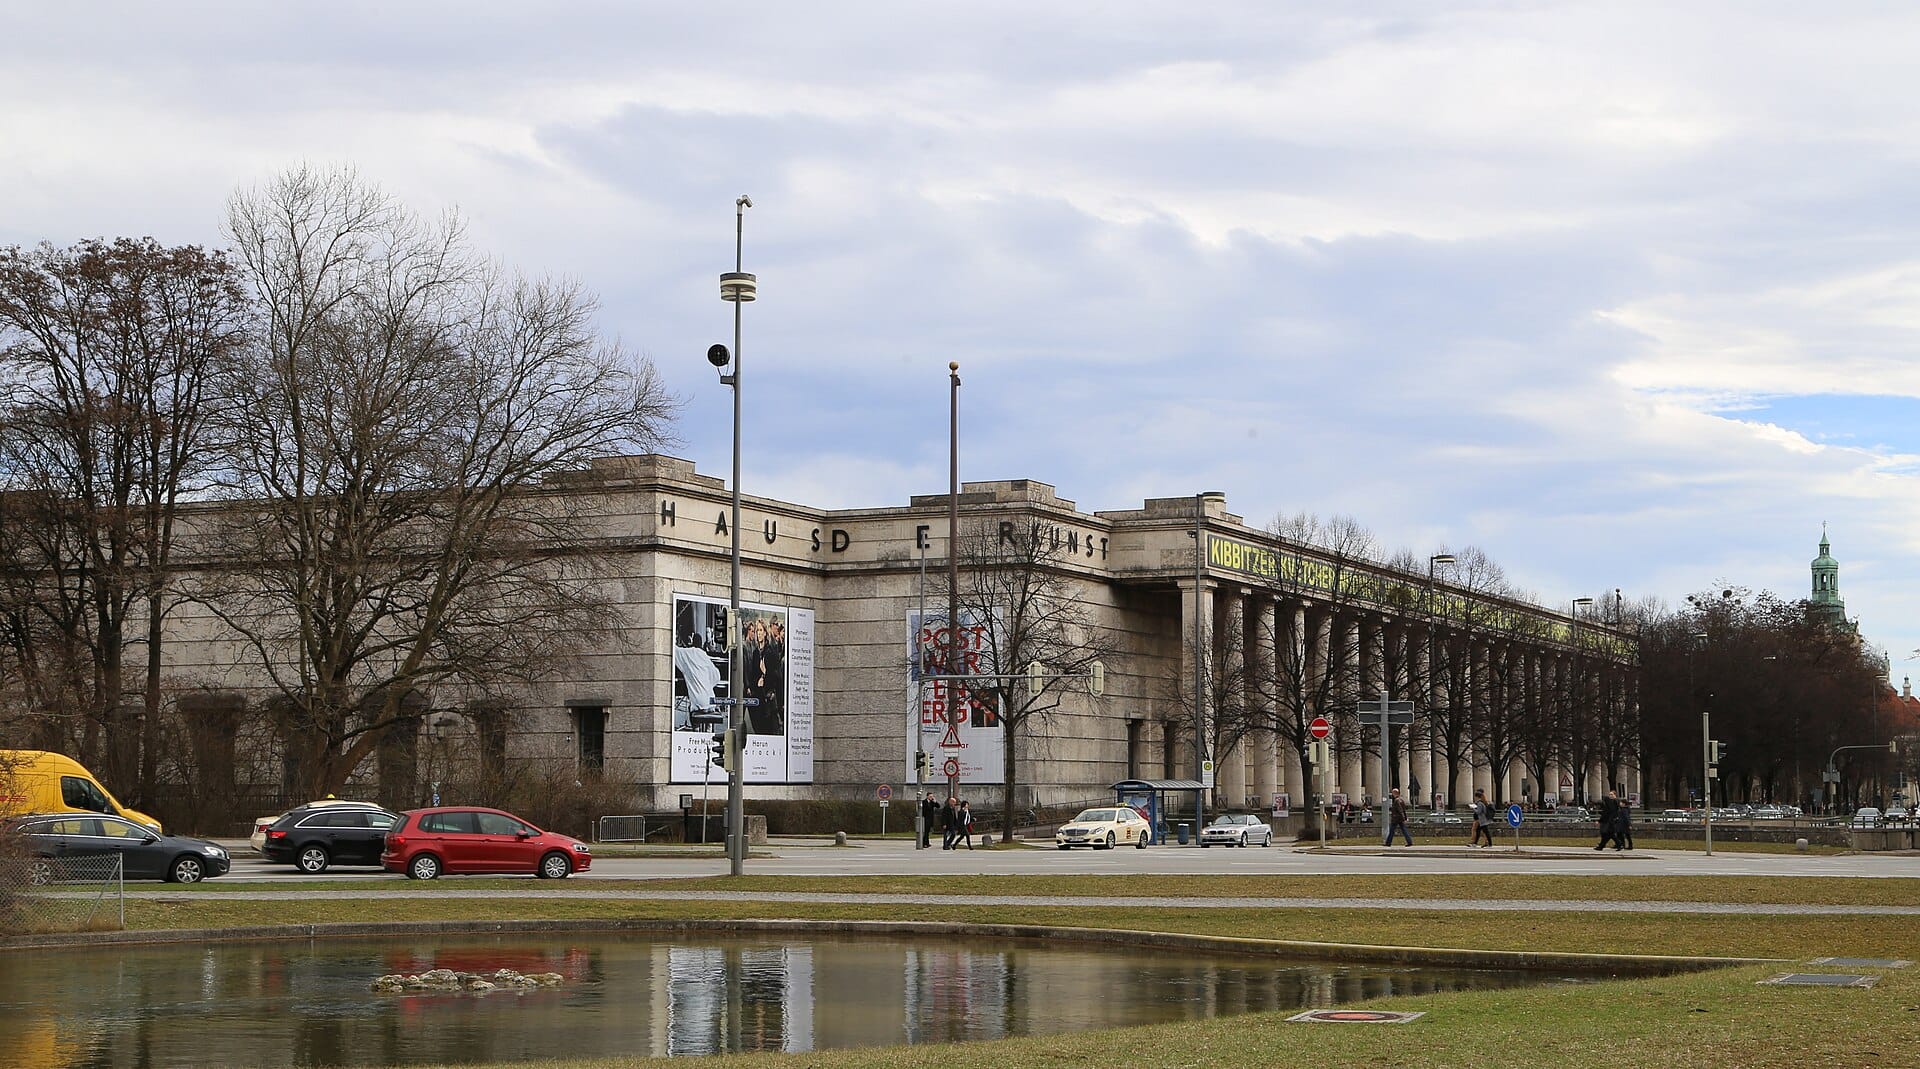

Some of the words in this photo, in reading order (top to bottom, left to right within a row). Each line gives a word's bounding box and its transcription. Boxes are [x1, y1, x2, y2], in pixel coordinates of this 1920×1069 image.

[661, 500, 820, 552] HAUS
[831, 521, 1017, 552] DER
[1031, 522, 1108, 560] KUNST
[1211, 537, 1277, 579] KIBBITZER
[916, 626, 985, 651] POST
[922, 700, 971, 724] ERG
